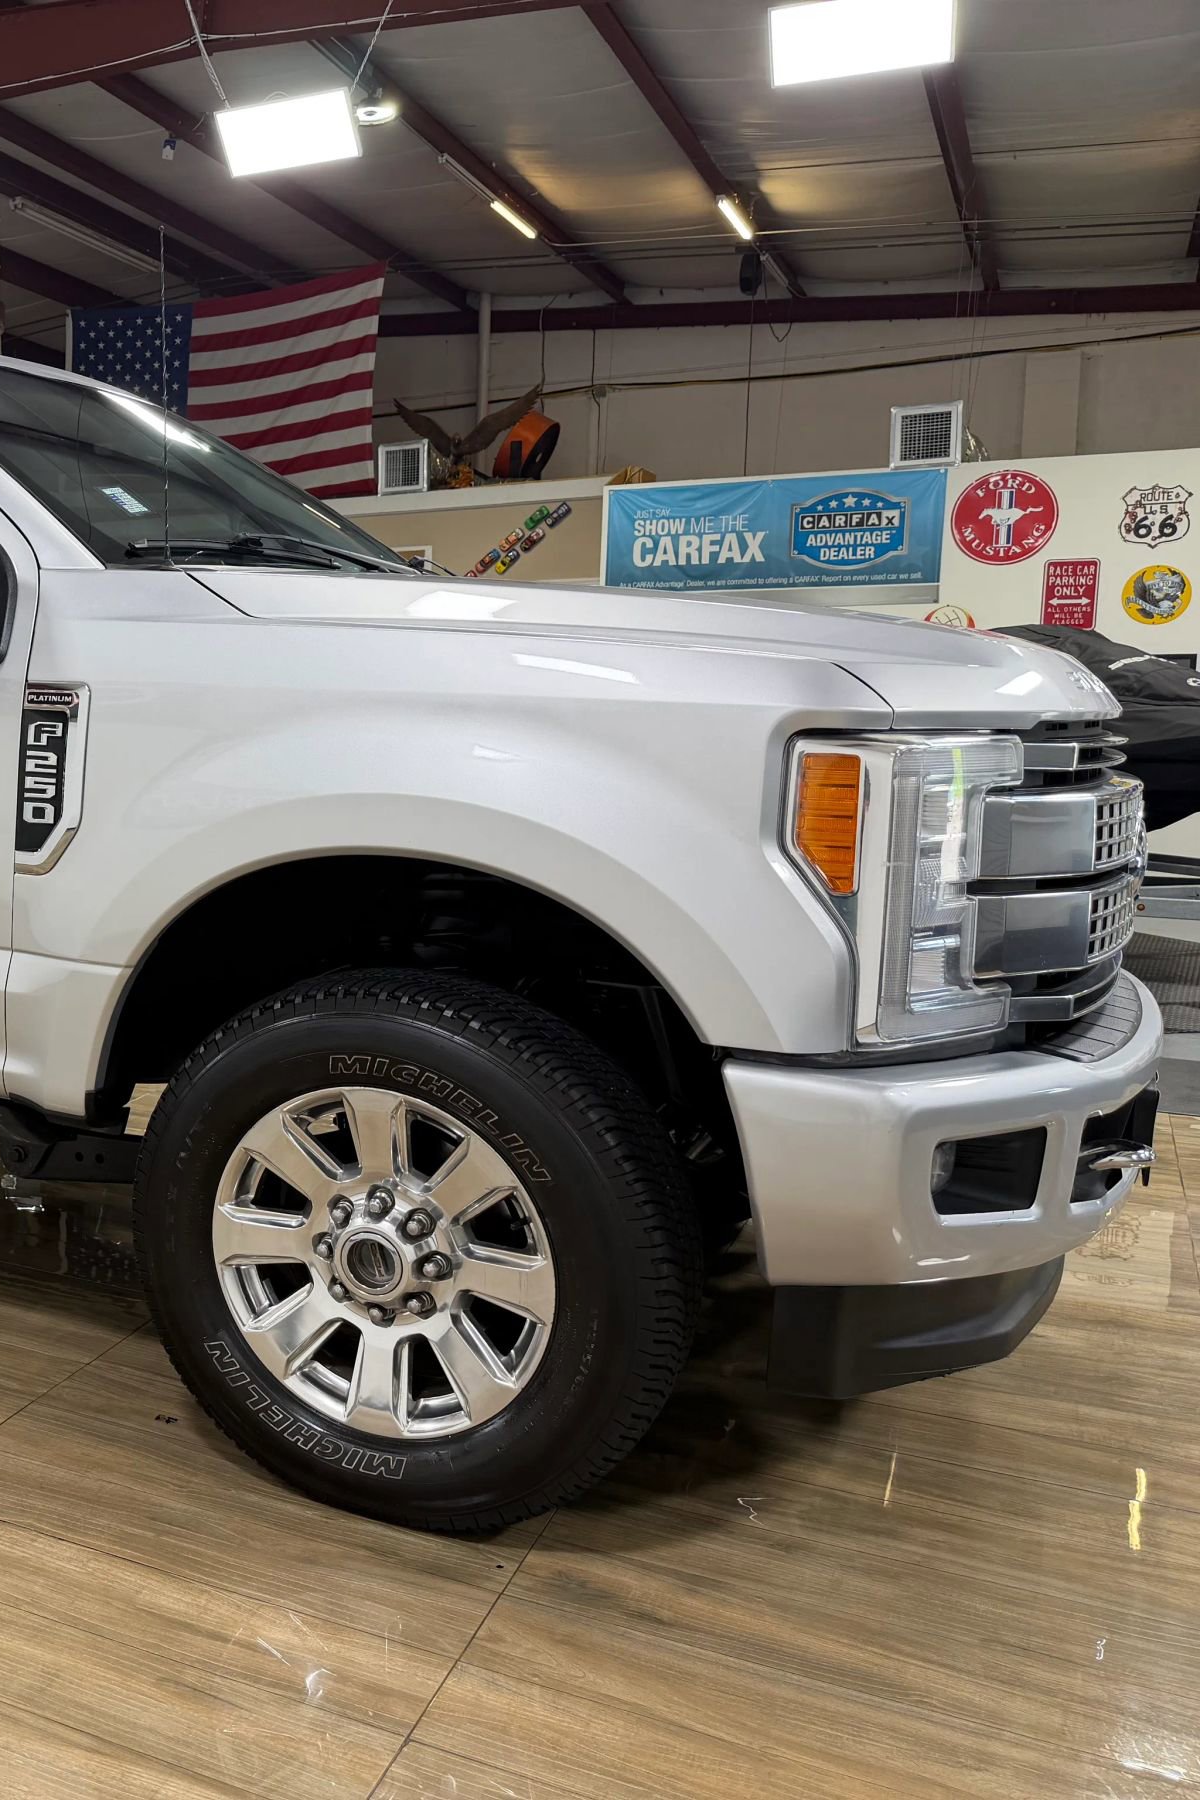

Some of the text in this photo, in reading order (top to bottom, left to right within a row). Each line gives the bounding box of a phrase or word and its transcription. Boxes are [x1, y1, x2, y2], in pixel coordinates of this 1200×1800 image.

[975, 476, 1036, 497] FORD
[1140, 491, 1174, 502] ROUTE
[634, 508, 670, 519] JUST SAY
[802, 513, 897, 529] CARFAX
[633, 514, 749, 536] SHOW ME THE
[1133, 514, 1178, 539] 66
[962, 523, 1046, 557] MUSTANG
[632, 531, 766, 568] CARFAX
[820, 546, 875, 561] DEALER
[1049, 565, 1095, 576] RACE CAR
[765, 576, 788, 585] offering
[870, 573, 886, 581] used
[1049, 575, 1093, 586] PARKING
[1054, 586, 1086, 596] ONLY
[28, 694, 72, 703] PLATINUM
[328, 1054, 552, 1183] MICHELIN
[203, 1339, 407, 1479] MICHELIN
